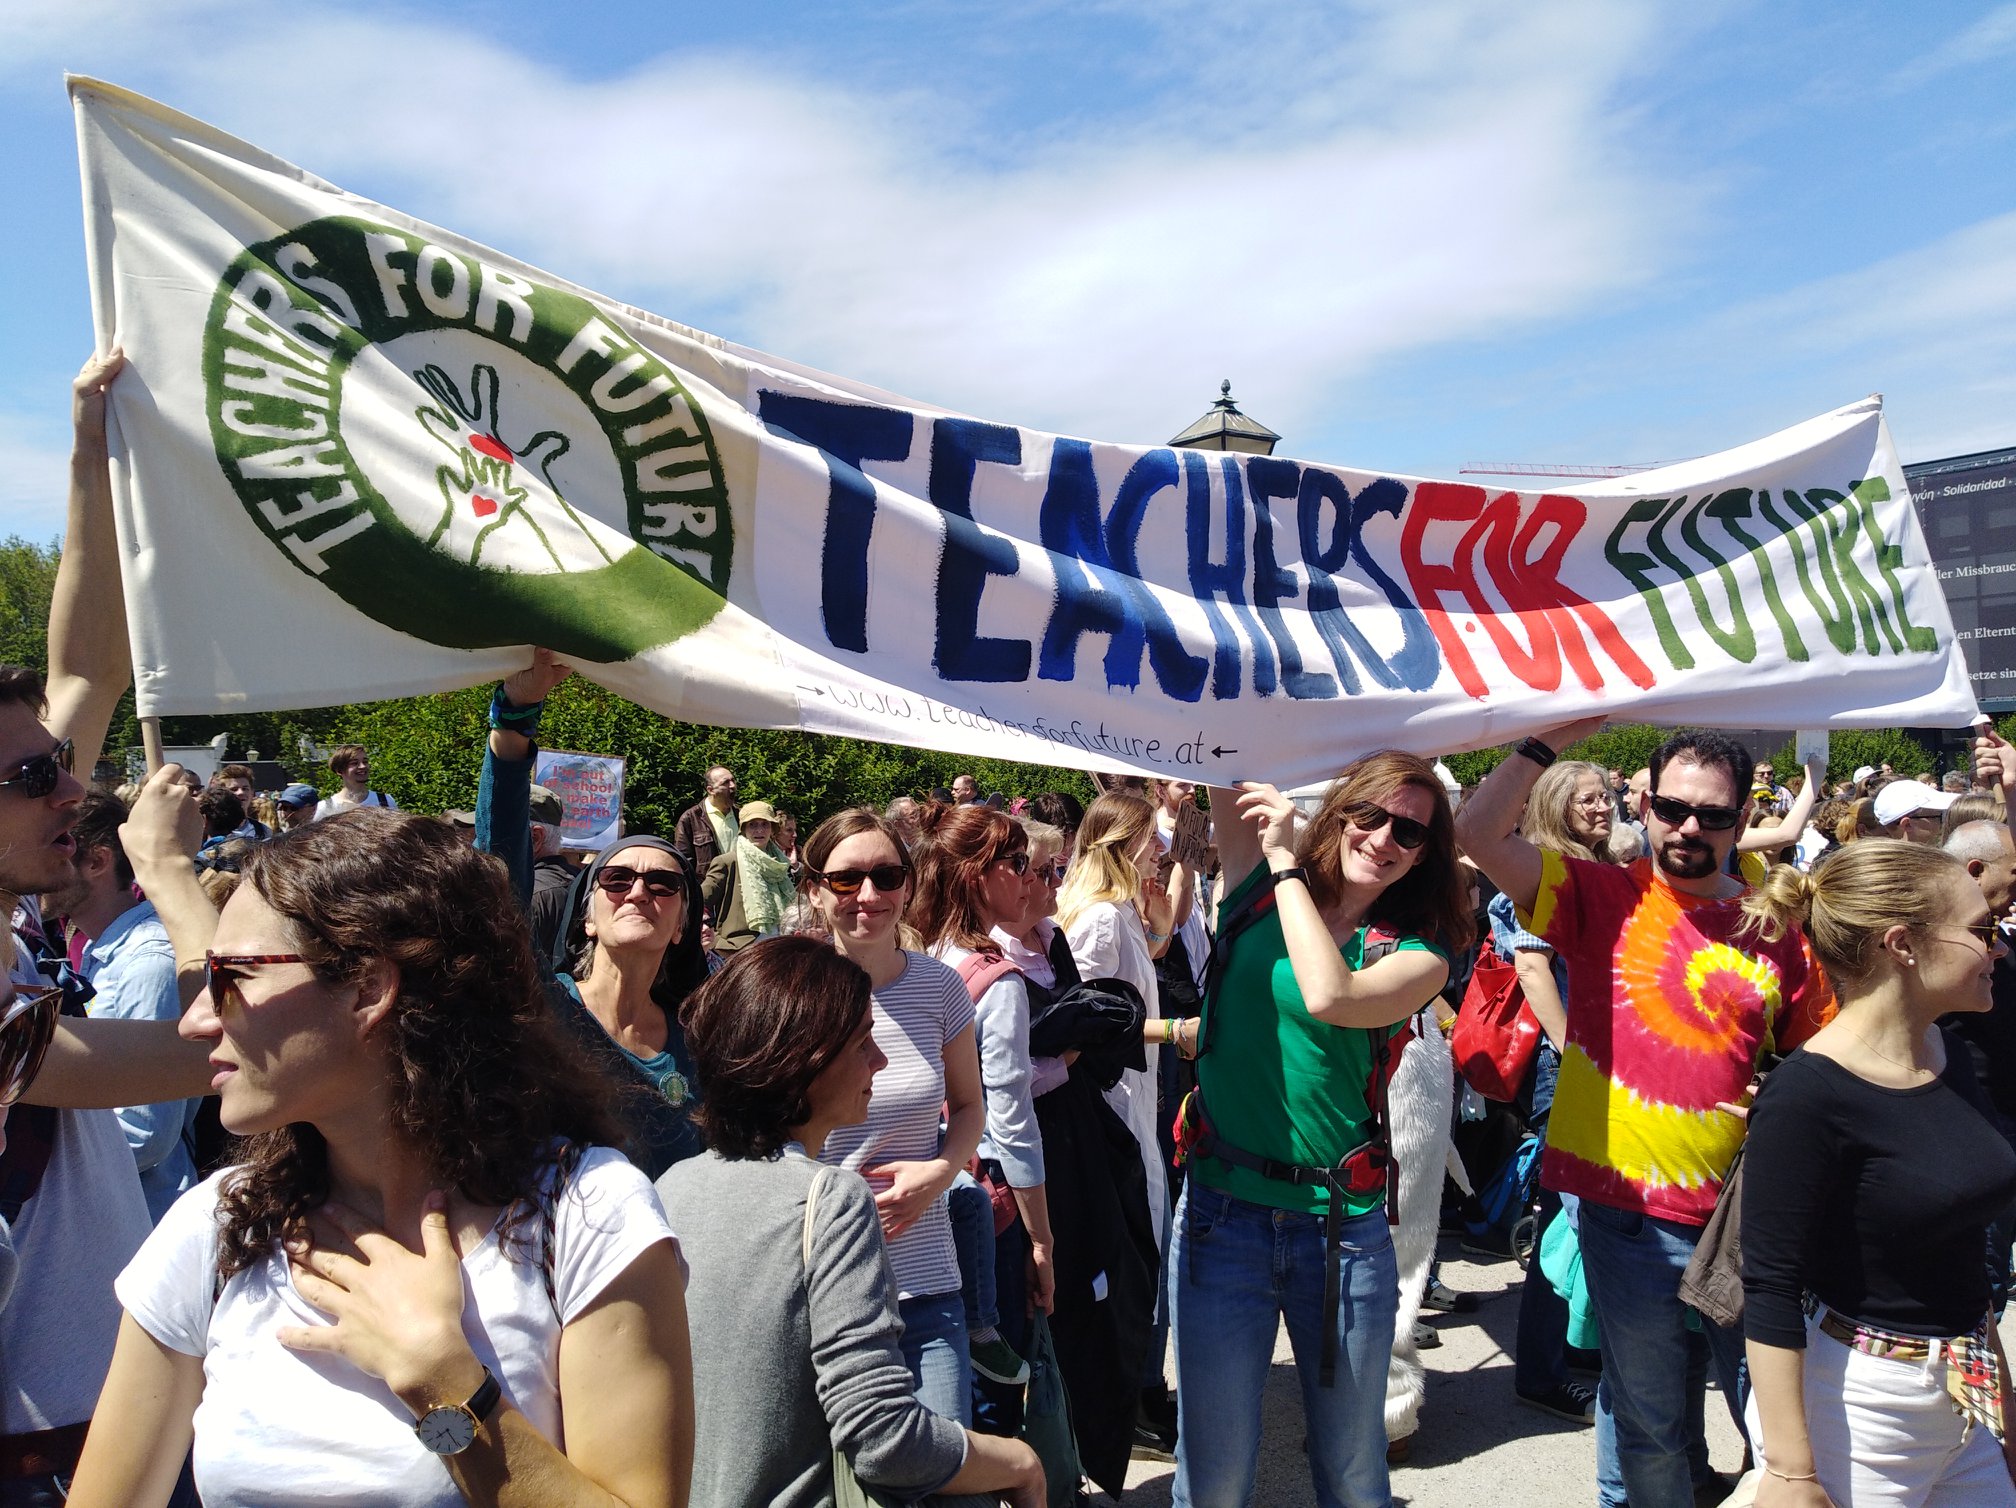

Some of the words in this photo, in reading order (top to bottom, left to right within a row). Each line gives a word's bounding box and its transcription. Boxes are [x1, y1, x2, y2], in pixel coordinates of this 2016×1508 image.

[222, 241, 377, 575] TEACHERS
[364, 230, 535, 346] FOR
[1943, 477, 2006, 497] Solidaridad
[758, 388, 1442, 702] TEACHERS
[1400, 482, 1656, 701] FOR
[1604, 476, 1938, 670] FUTURE
[562, 781, 612, 793] school
[567, 793, 607, 804] make
[571, 806, 610, 817] earth
